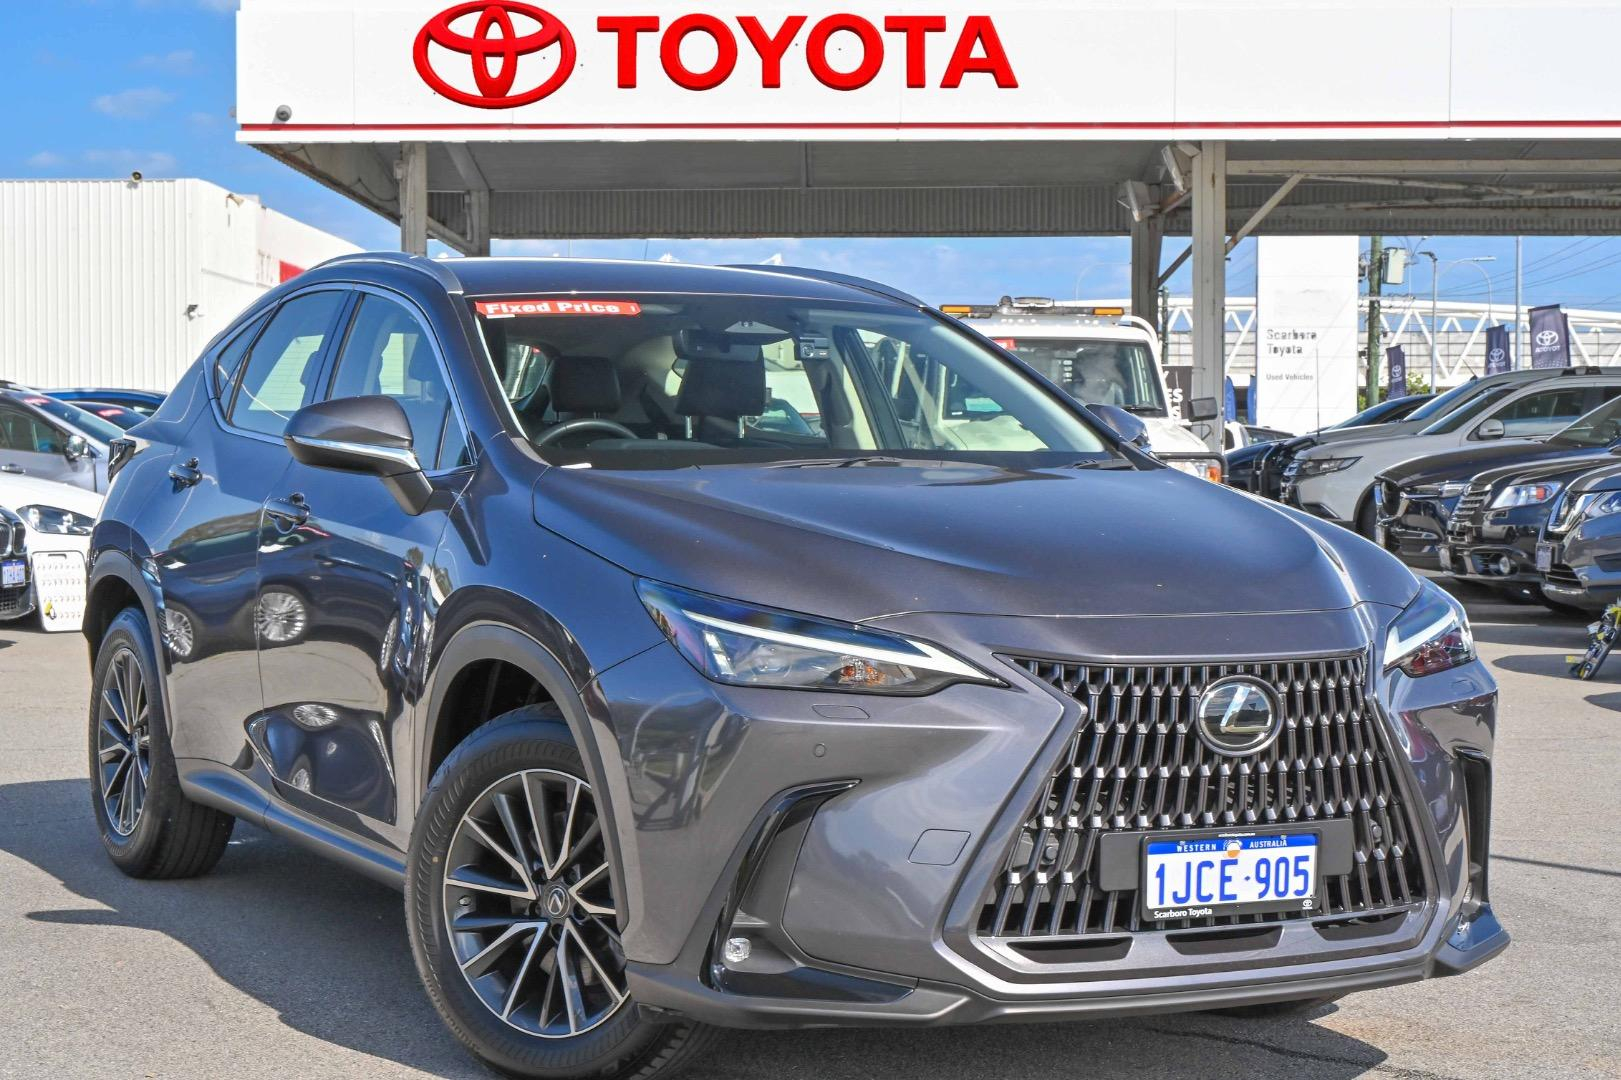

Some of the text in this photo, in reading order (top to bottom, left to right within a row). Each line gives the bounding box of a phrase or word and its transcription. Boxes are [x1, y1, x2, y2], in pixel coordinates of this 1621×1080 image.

[597, 13, 1019, 91] TOYOTA
[485, 302, 620, 314] Fixed Price
[1266, 343, 1303, 357] Toyota
[1177, 839, 1288, 853] WESTERN AUSTRALIA
[1154, 907, 1213, 919] Scarboro Toyota
